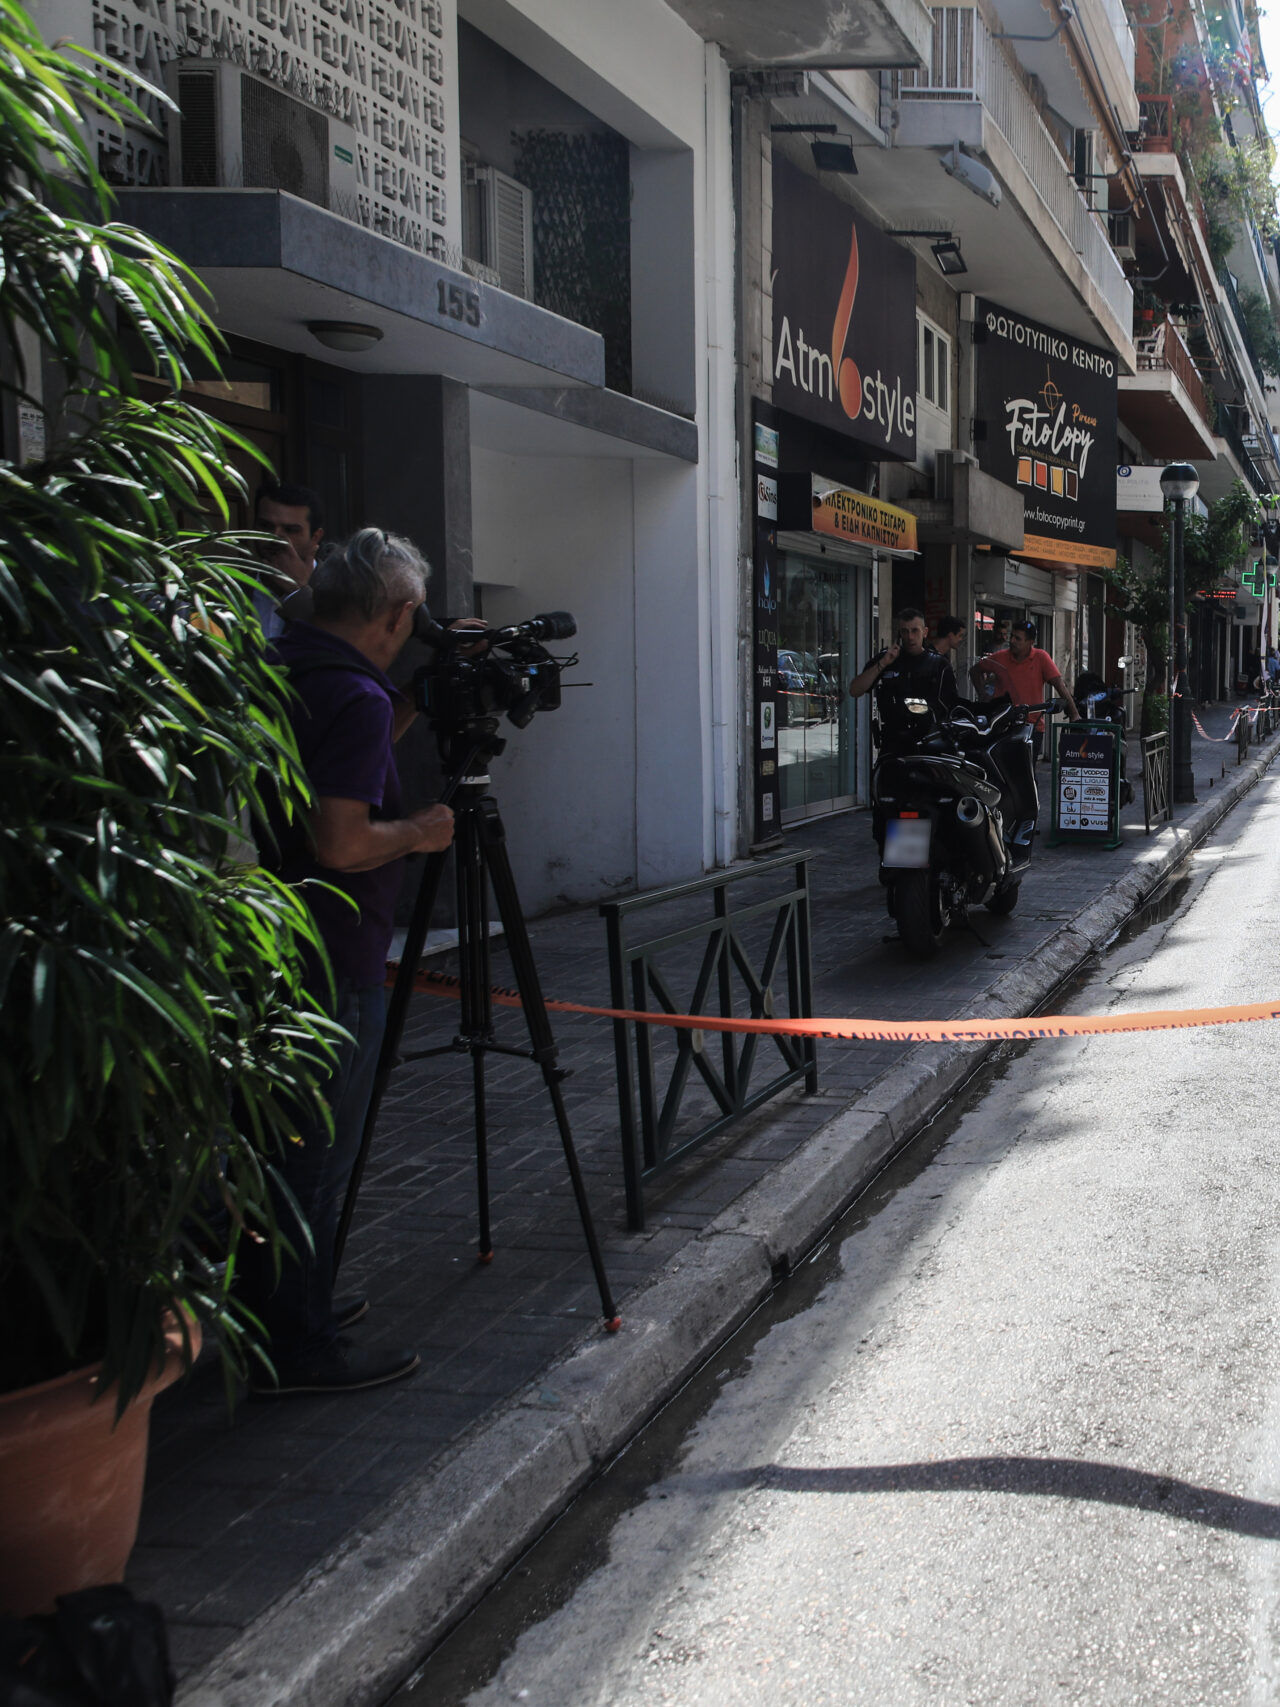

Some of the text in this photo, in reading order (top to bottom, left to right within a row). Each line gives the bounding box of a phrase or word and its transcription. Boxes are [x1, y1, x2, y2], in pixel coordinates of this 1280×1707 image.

[437, 279, 480, 328] 155
[986, 312, 1114, 378] ΦΩΤΟΤΥΠΙΚΟ ΚΕΝΤΡΟ
[834, 512, 899, 547] & ΕΙΔΗ ΚΑΠΝΙΣΤΟΥ
[1024, 506, 1086, 533] ww.fotocopyprint.gr
